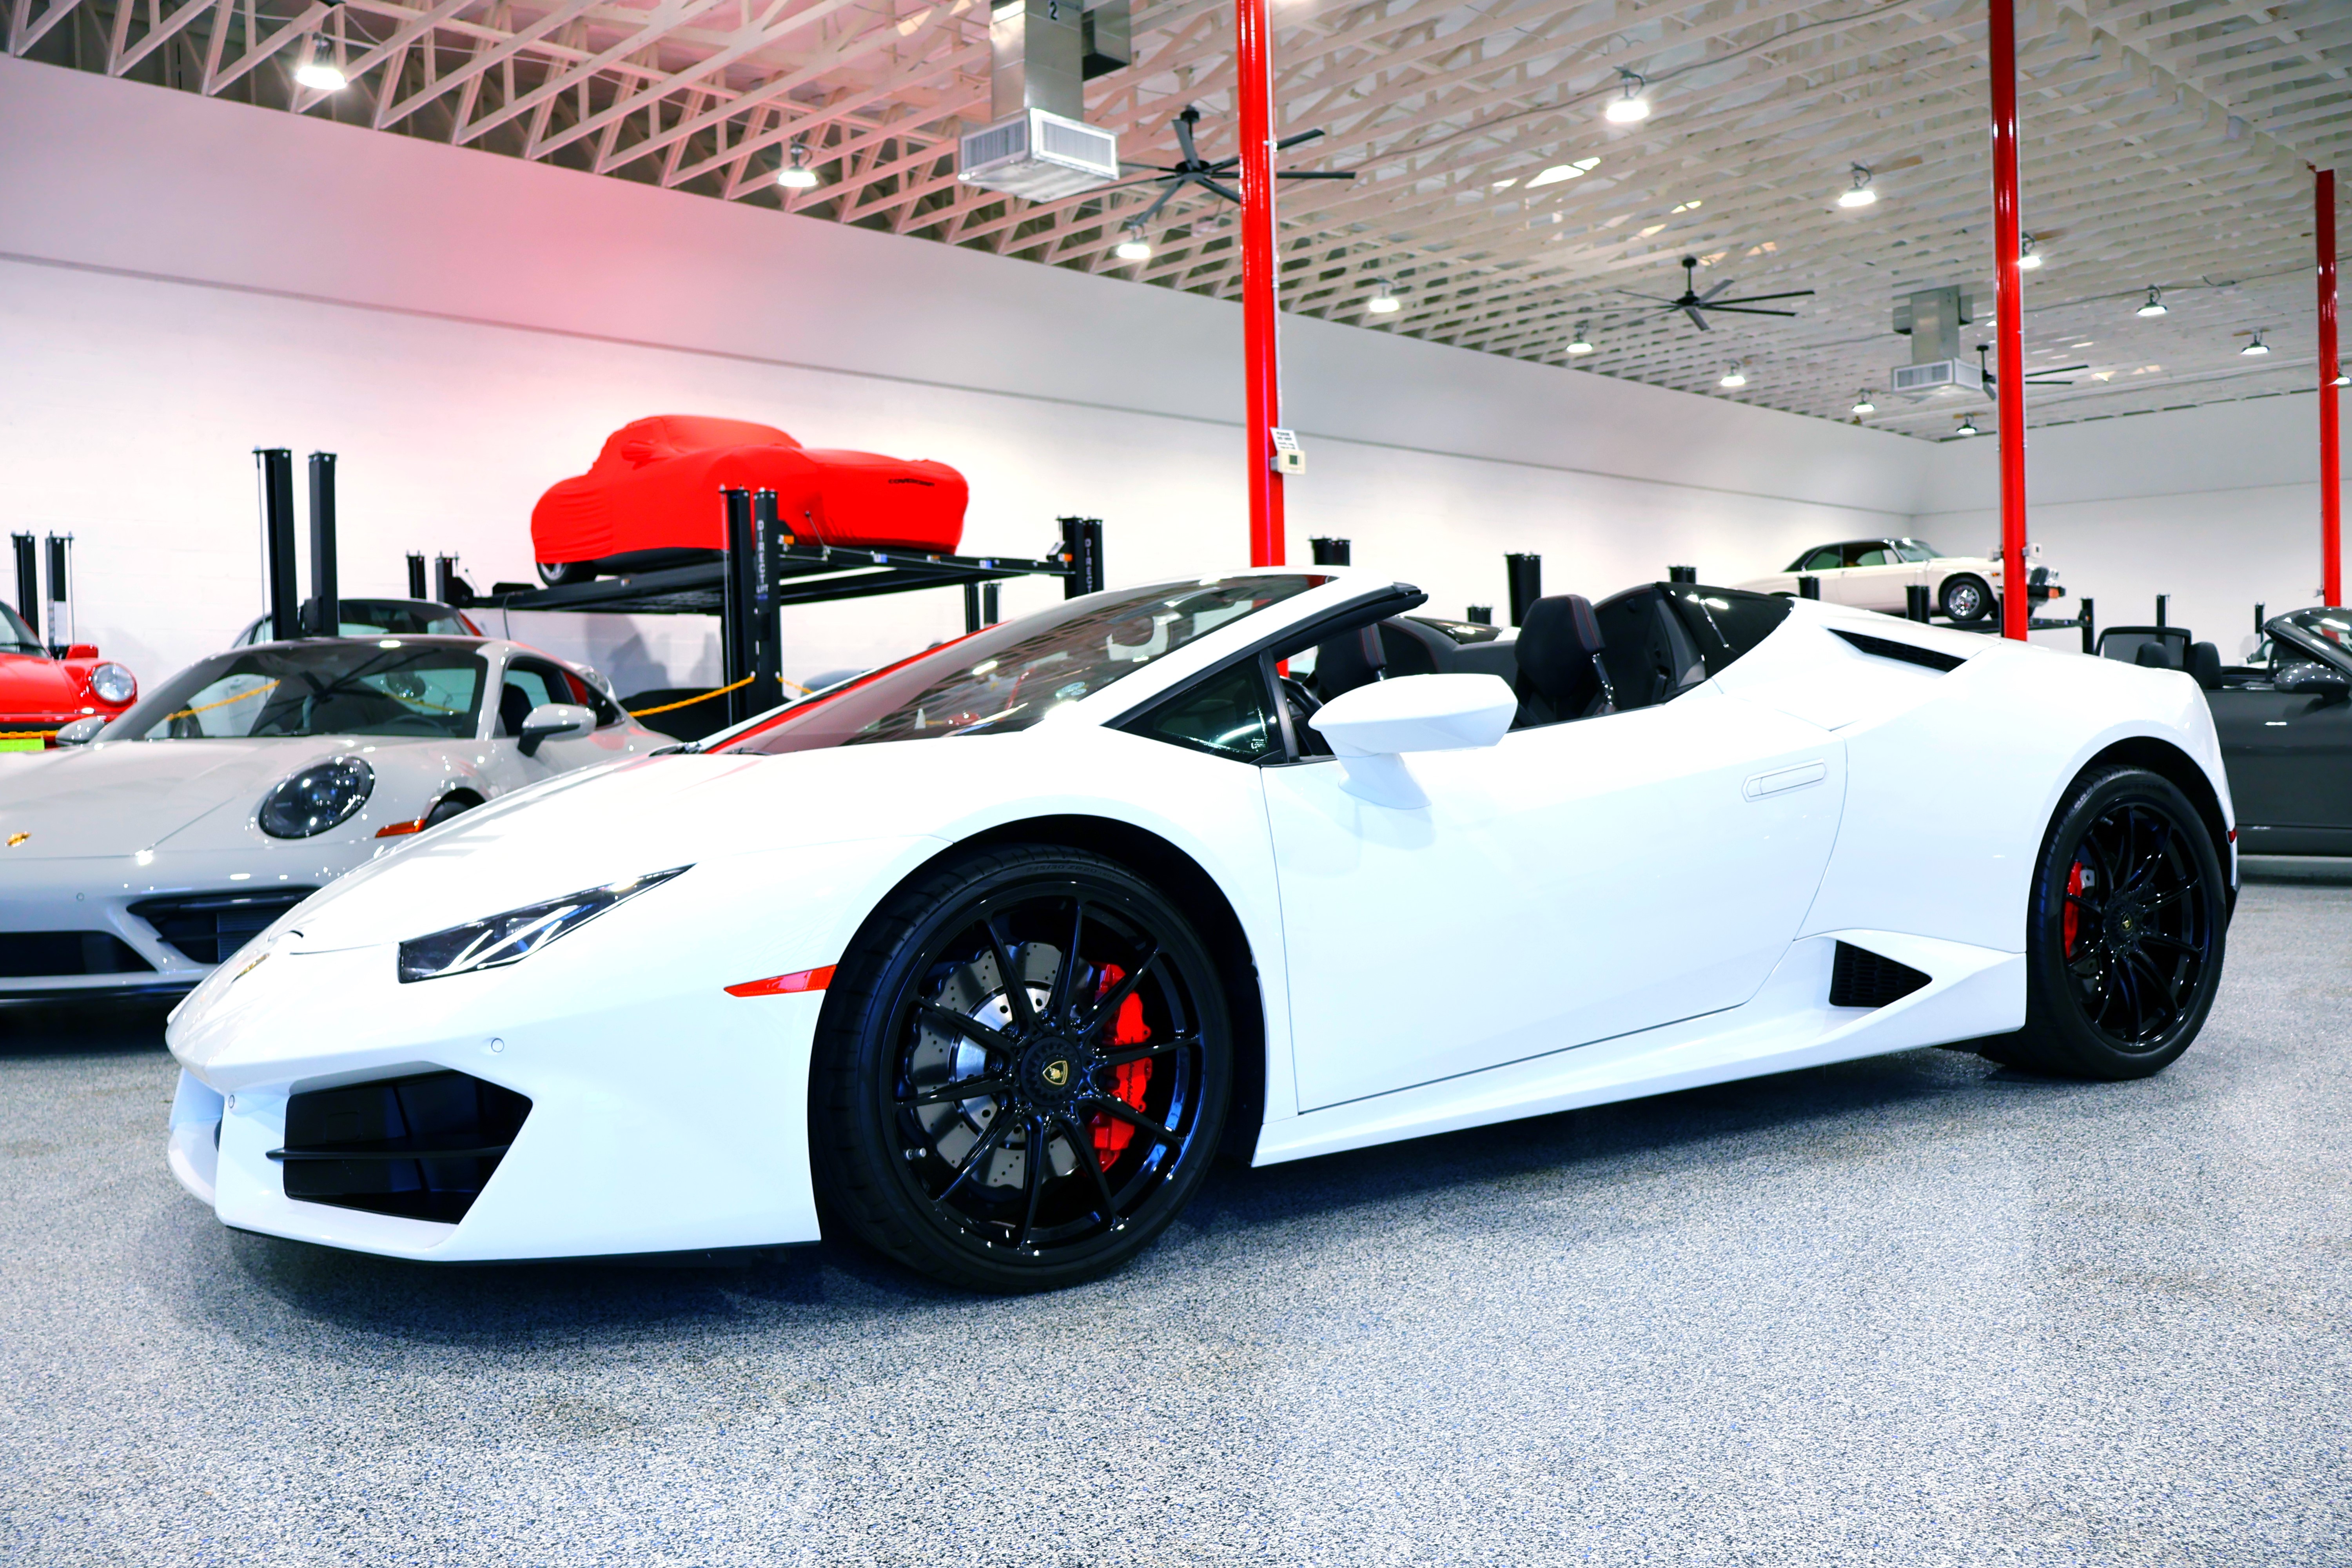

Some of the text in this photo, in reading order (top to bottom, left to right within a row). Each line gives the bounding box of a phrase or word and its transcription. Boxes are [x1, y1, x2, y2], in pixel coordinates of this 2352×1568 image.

[1049, 1, 1058, 21] 2
[757, 519, 766, 584] DIRECT
[1084, 538, 1093, 593] DIRECT
[1067, 865, 1097, 873] ZR20
